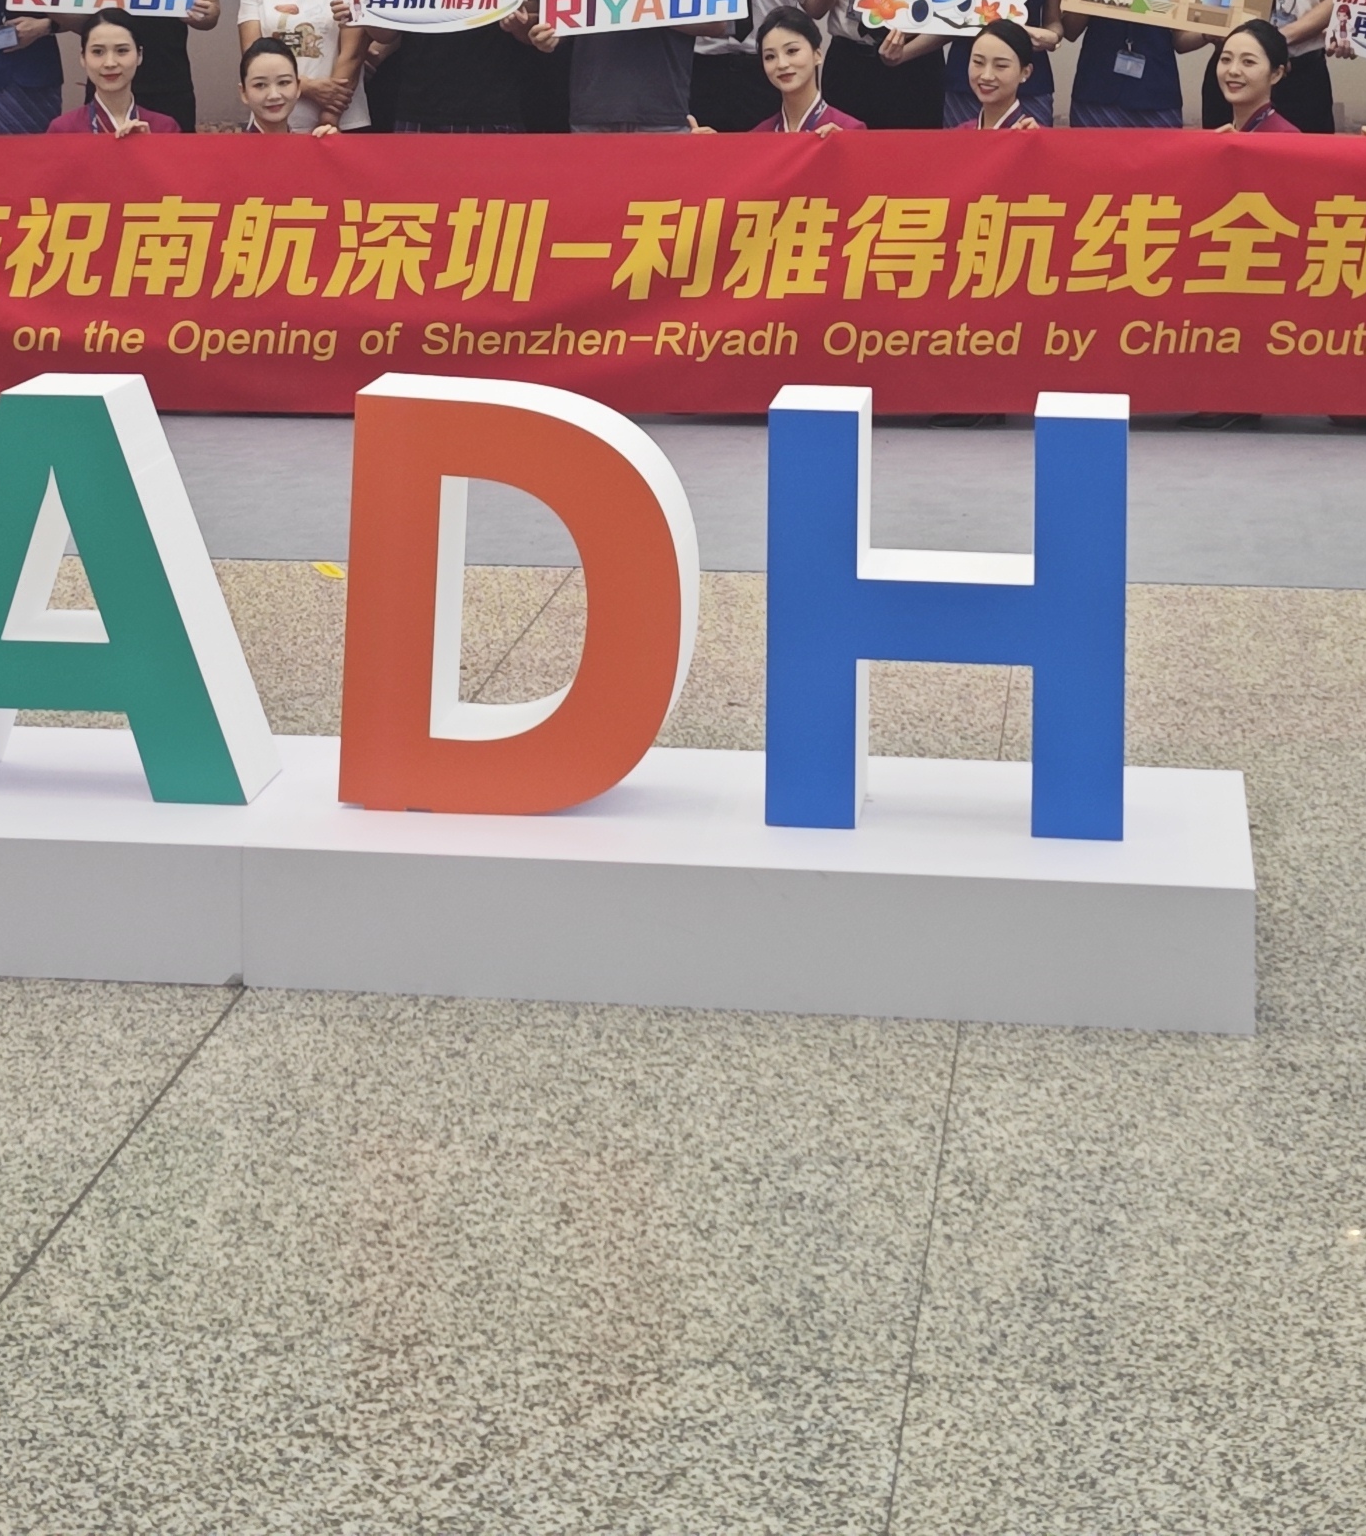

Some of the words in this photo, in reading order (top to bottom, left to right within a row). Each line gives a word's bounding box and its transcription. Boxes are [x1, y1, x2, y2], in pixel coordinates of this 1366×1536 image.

[12, 324, 60, 352] on
[84, 319, 145, 354] the
[168, 321, 338, 362] Opening
[359, 321, 403, 356] of
[822, 321, 1022, 363] Operated
[1044, 321, 1097, 362] by
[1119, 320, 1242, 356] China
